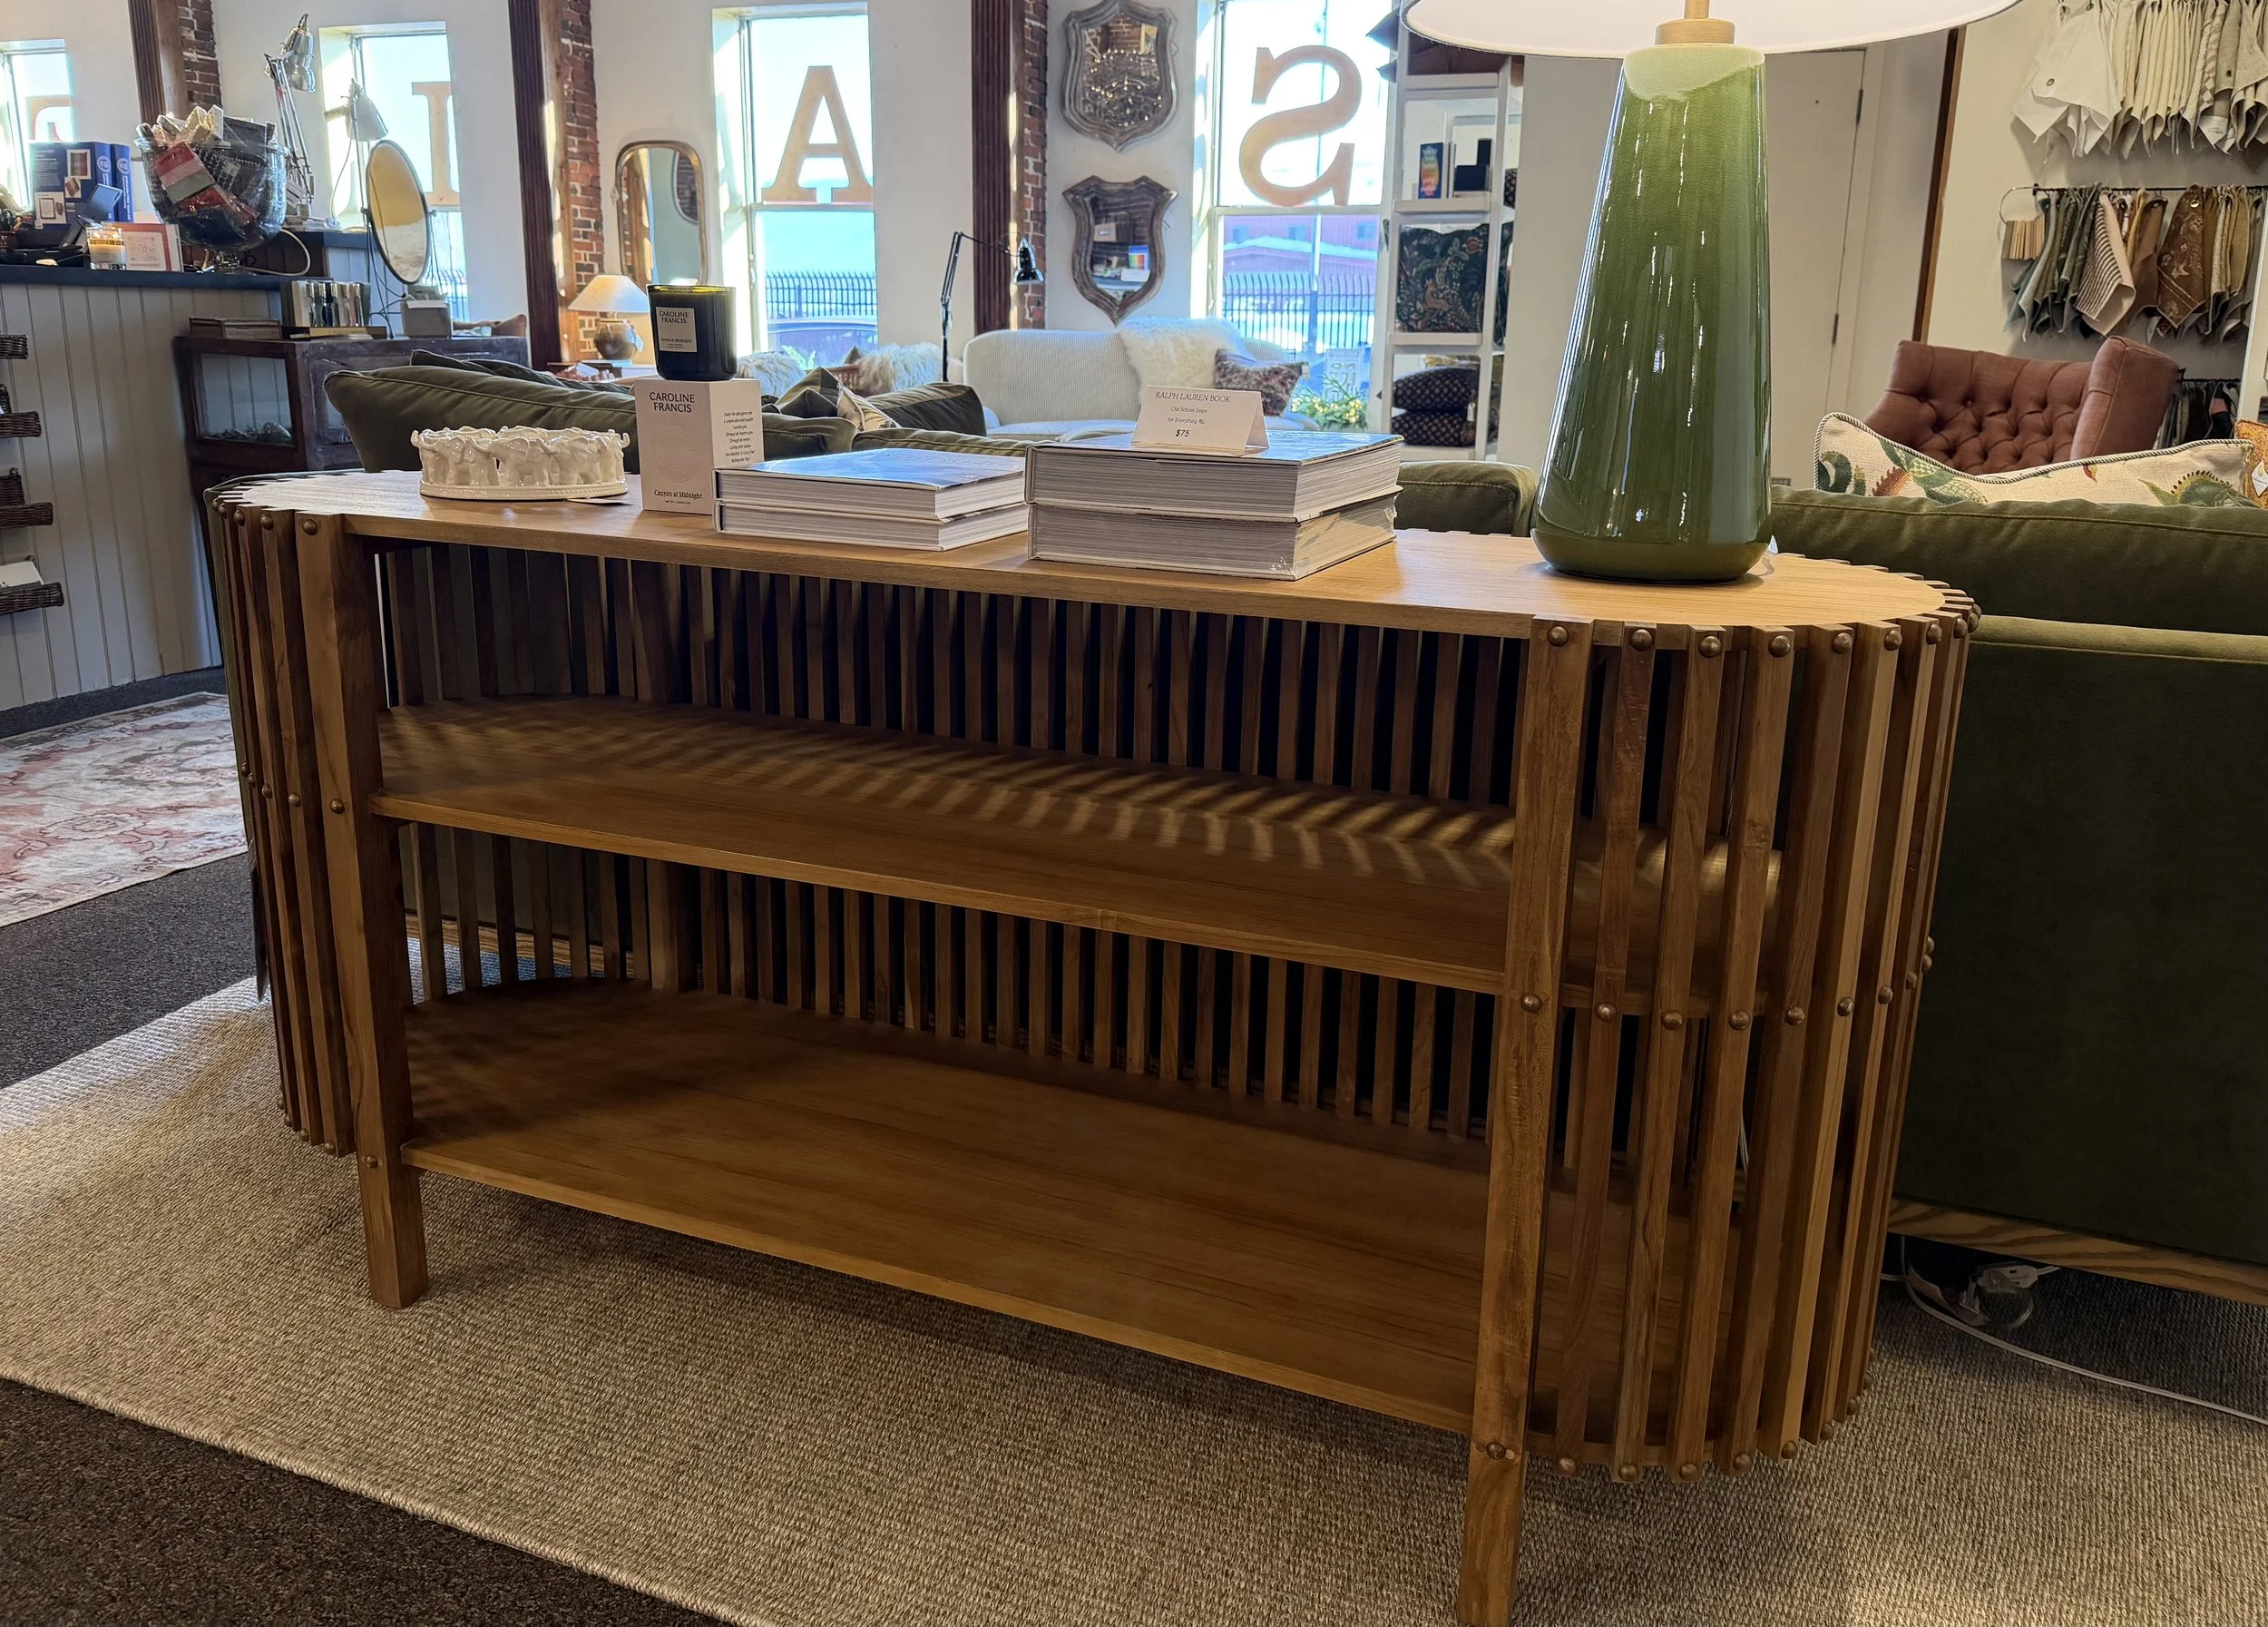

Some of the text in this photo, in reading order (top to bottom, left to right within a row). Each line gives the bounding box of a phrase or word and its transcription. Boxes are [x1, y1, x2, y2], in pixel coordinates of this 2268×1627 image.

[659, 310, 689, 319] CAROLINE
[650, 391, 695, 403] CAROLINE
[1155, 391, 1231, 403] RALPH LAUREN BOOK
[653, 402, 692, 413] FRANCIS
[1175, 428, 1190, 437] $75
[654, 489, 673, 497] Canyon
[679, 491, 703, 500] Midnight
